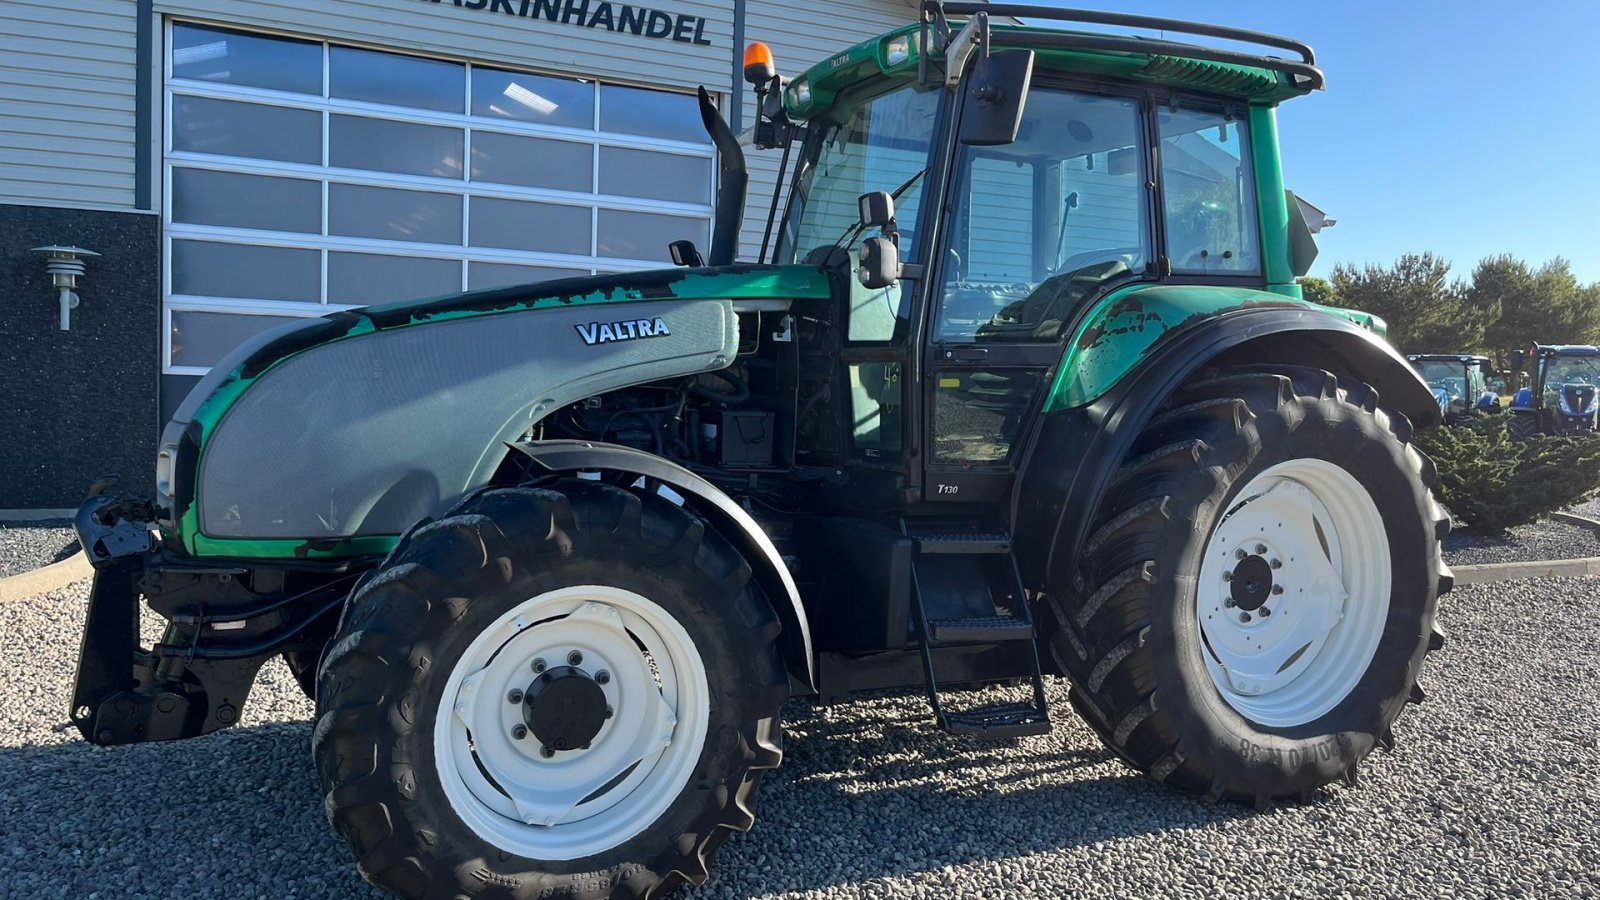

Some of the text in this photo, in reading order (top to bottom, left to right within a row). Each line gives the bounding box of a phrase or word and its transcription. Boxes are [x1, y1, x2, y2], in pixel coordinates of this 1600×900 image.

[424, 0, 711, 46] KINHANDEL
[575, 318, 671, 345] VALTRA
[938, 484, 959, 494] T130
